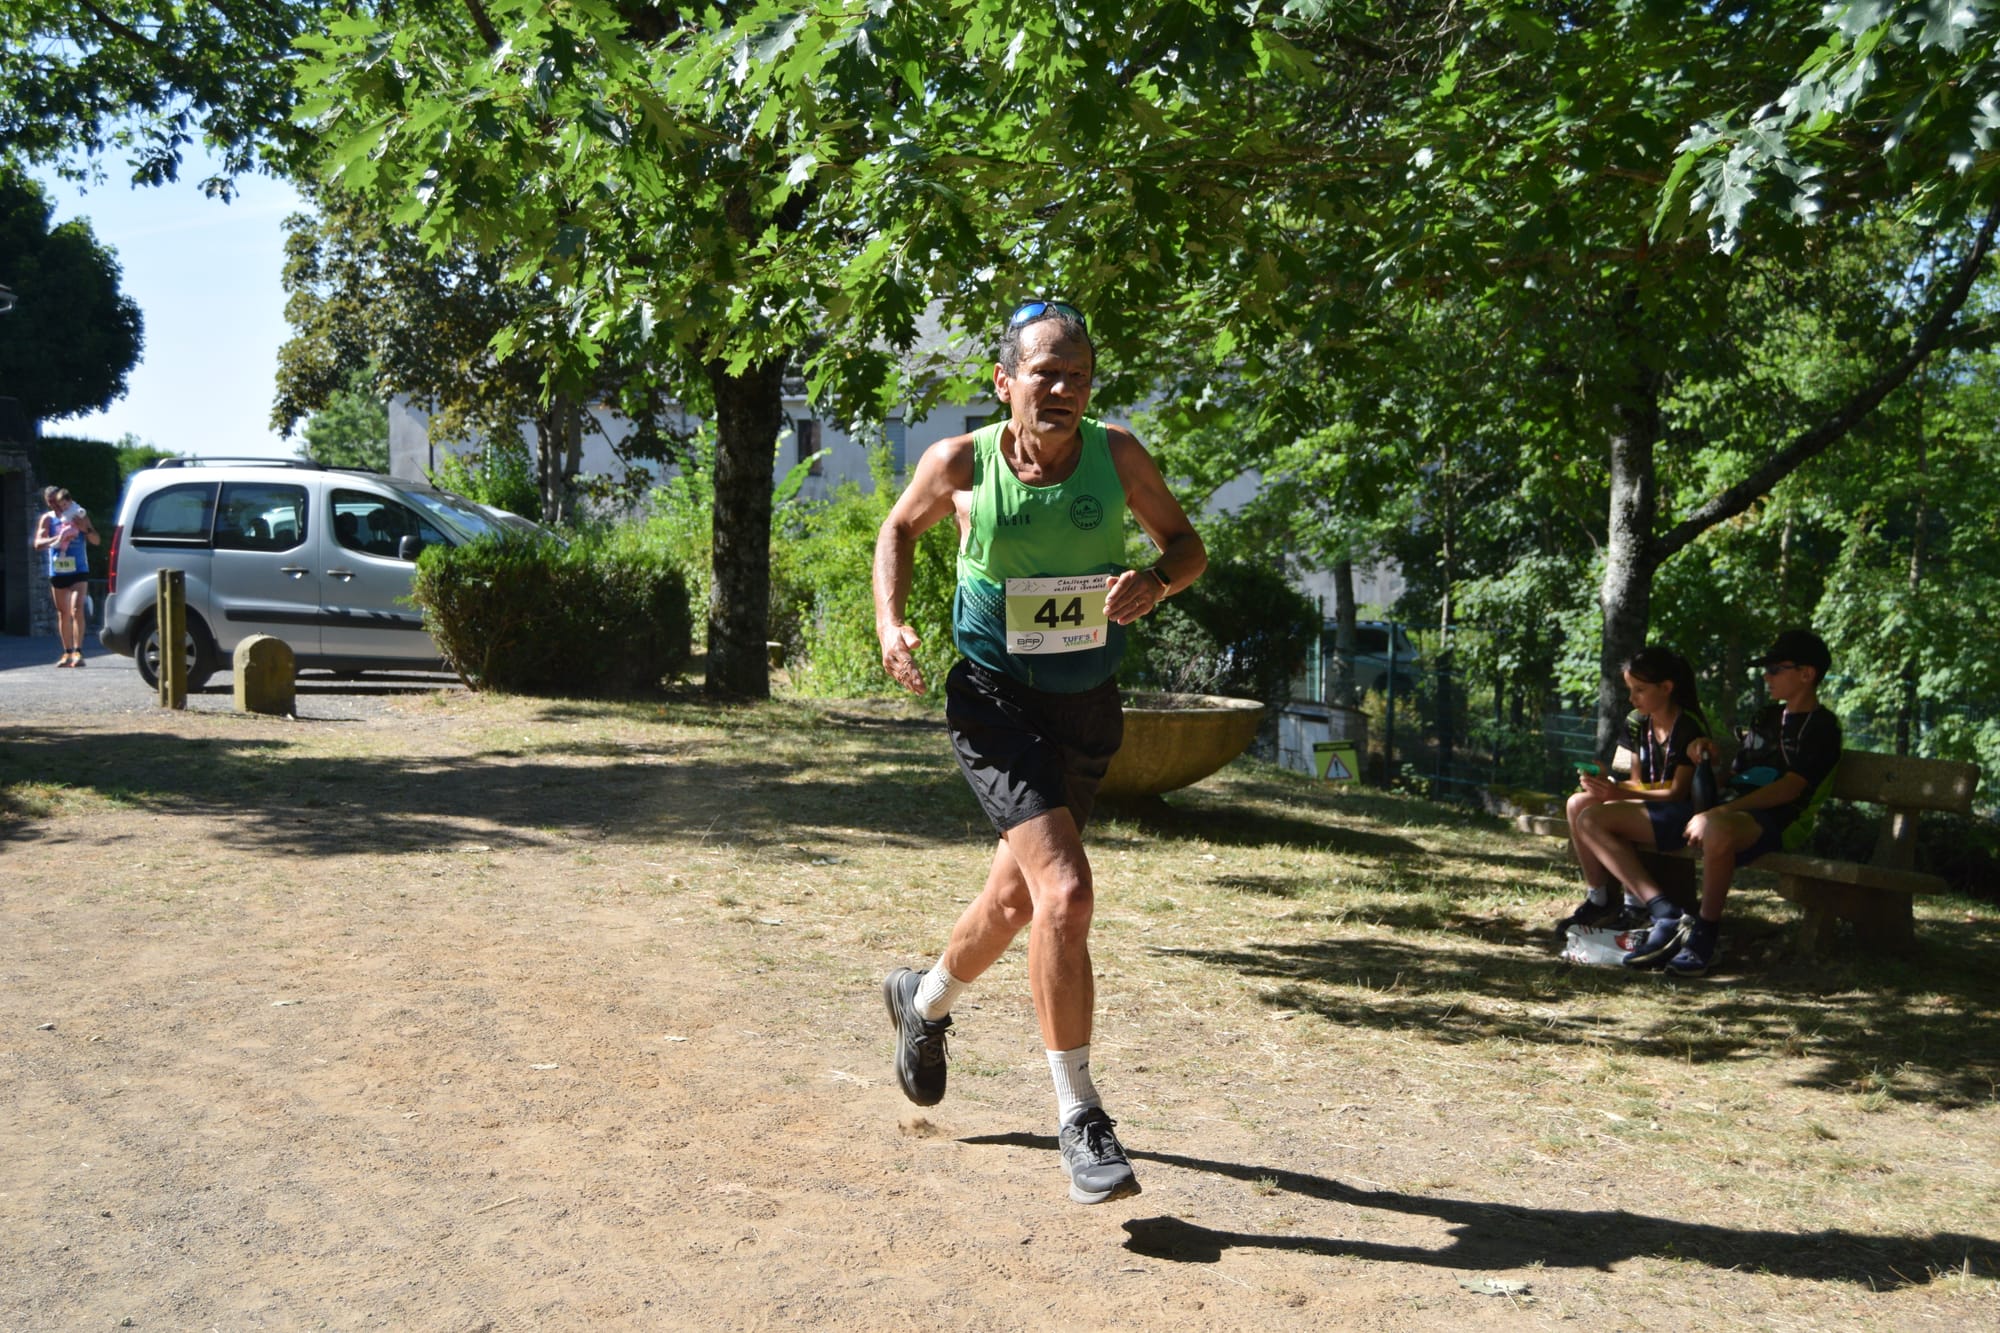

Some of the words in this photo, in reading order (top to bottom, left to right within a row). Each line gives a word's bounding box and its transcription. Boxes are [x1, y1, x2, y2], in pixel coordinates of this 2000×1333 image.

[1057, 579, 1089, 587] Challenge
[1034, 597, 1084, 628] 44
[1062, 634, 1090, 643] TUFF'S
